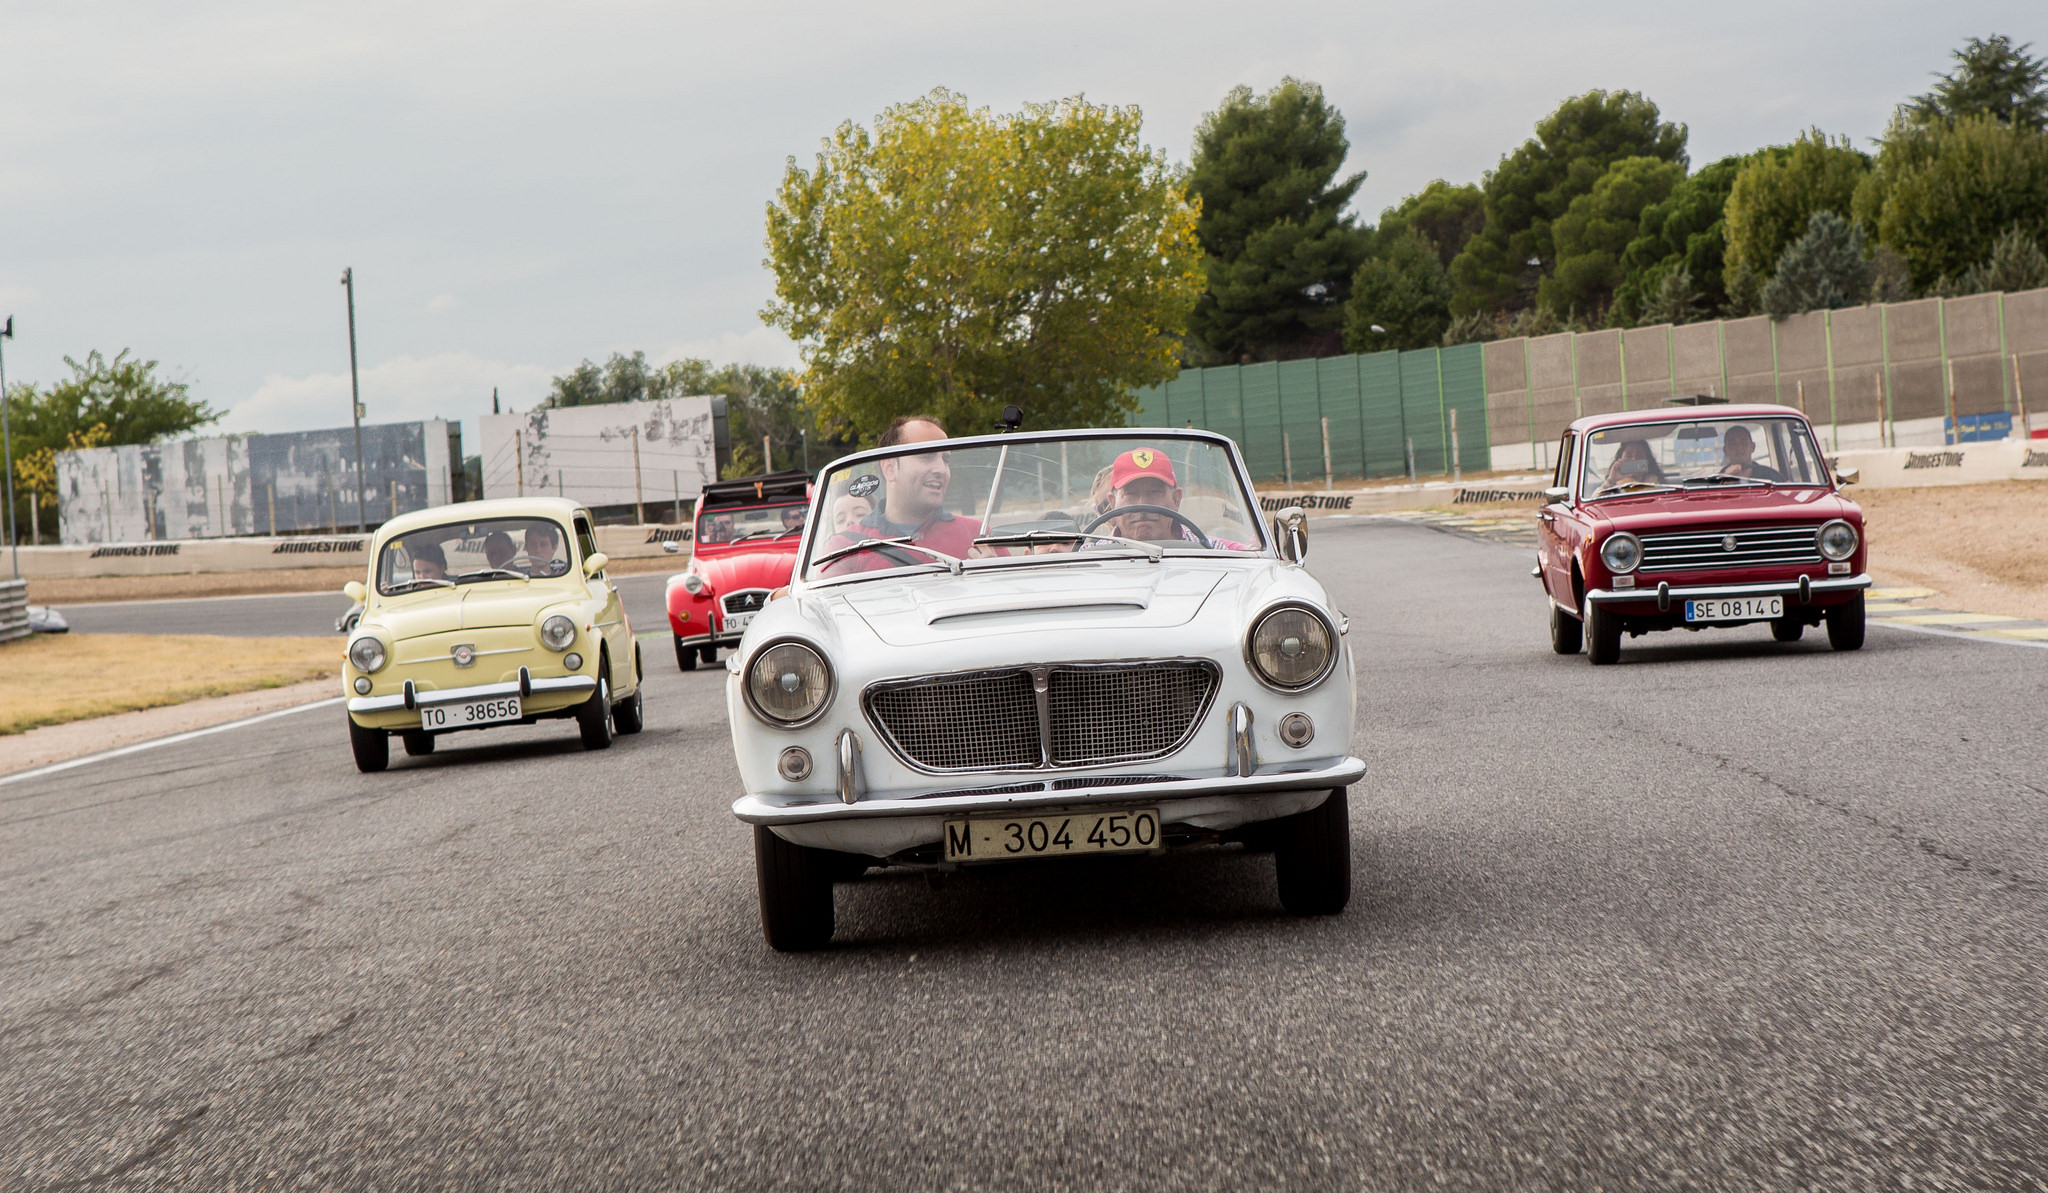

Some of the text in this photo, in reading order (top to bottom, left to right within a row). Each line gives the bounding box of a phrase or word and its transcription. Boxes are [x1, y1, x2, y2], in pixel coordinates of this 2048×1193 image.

[1453, 488, 1545, 504] BRIDGESTON
[90, 544, 181, 558] BRIDGESTONE
[272, 540, 364, 553] BRIDGESTONE
[1695, 599, 1780, 618] SE 0814 C
[424, 699, 518, 726] TO 38656
[949, 813, 1156, 857] M 304 450
